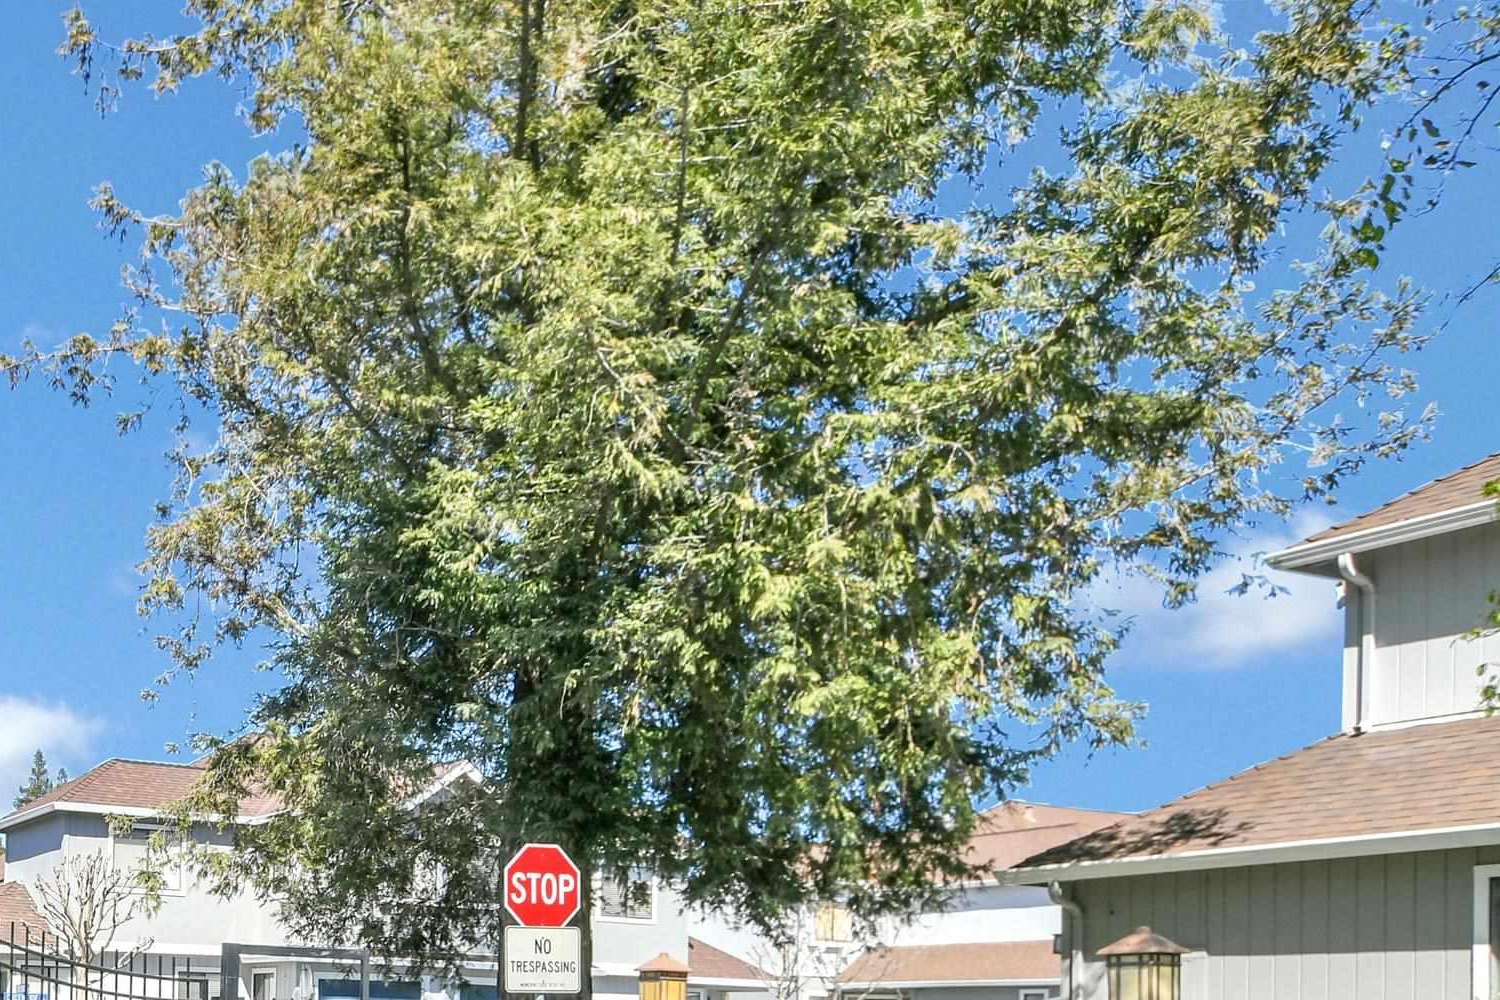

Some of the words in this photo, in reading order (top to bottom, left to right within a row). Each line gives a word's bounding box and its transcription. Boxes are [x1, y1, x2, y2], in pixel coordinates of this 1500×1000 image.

[510, 871, 575, 905] STOP
[534, 938, 552, 954] NO
[510, 960, 576, 973] TRESPASSING
